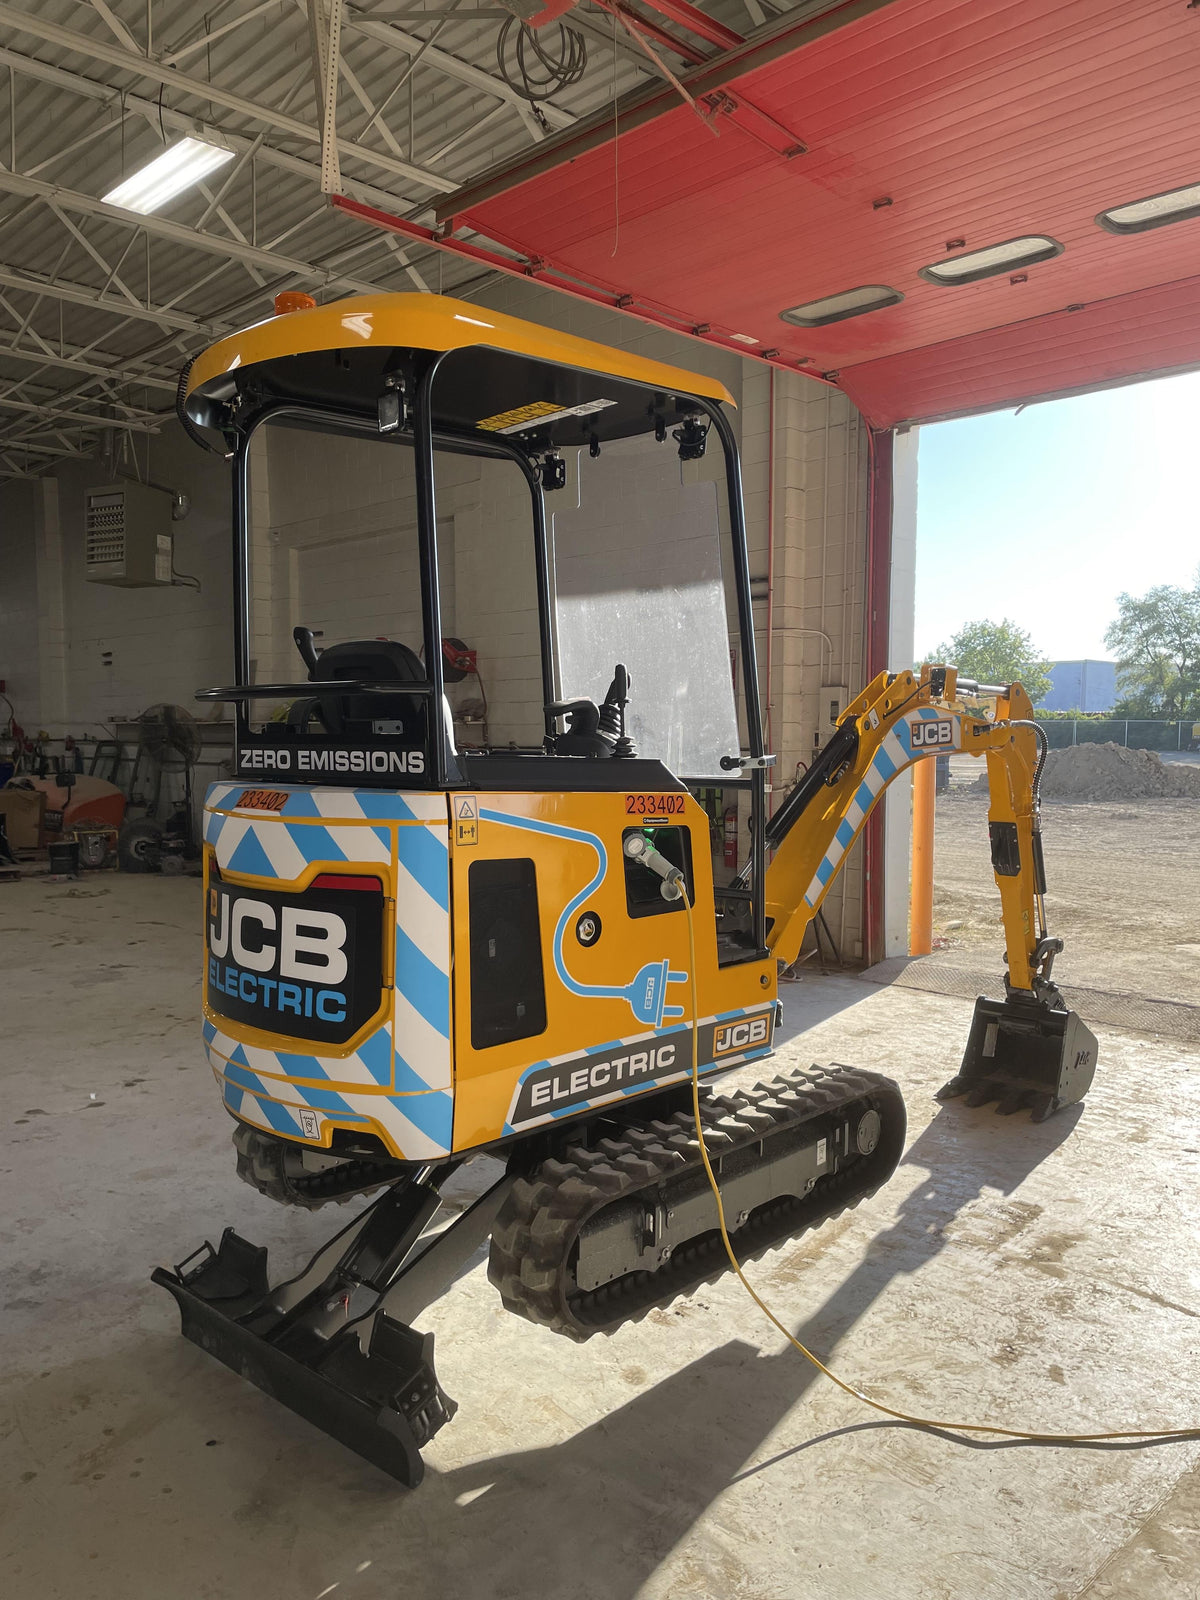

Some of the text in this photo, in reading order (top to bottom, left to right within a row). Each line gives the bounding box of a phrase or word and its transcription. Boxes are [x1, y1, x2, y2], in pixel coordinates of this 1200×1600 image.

[912, 722, 951, 745] JCB
[240, 750, 425, 774] ZERO EMISSIONS
[236, 790, 289, 812] 233402
[626, 795, 685, 814] 233402
[210, 892, 348, 985] JCB
[209, 957, 347, 1023] ELECTRIC
[716, 1019, 766, 1051] JCB
[531, 1044, 676, 1107] ELECTRIC
